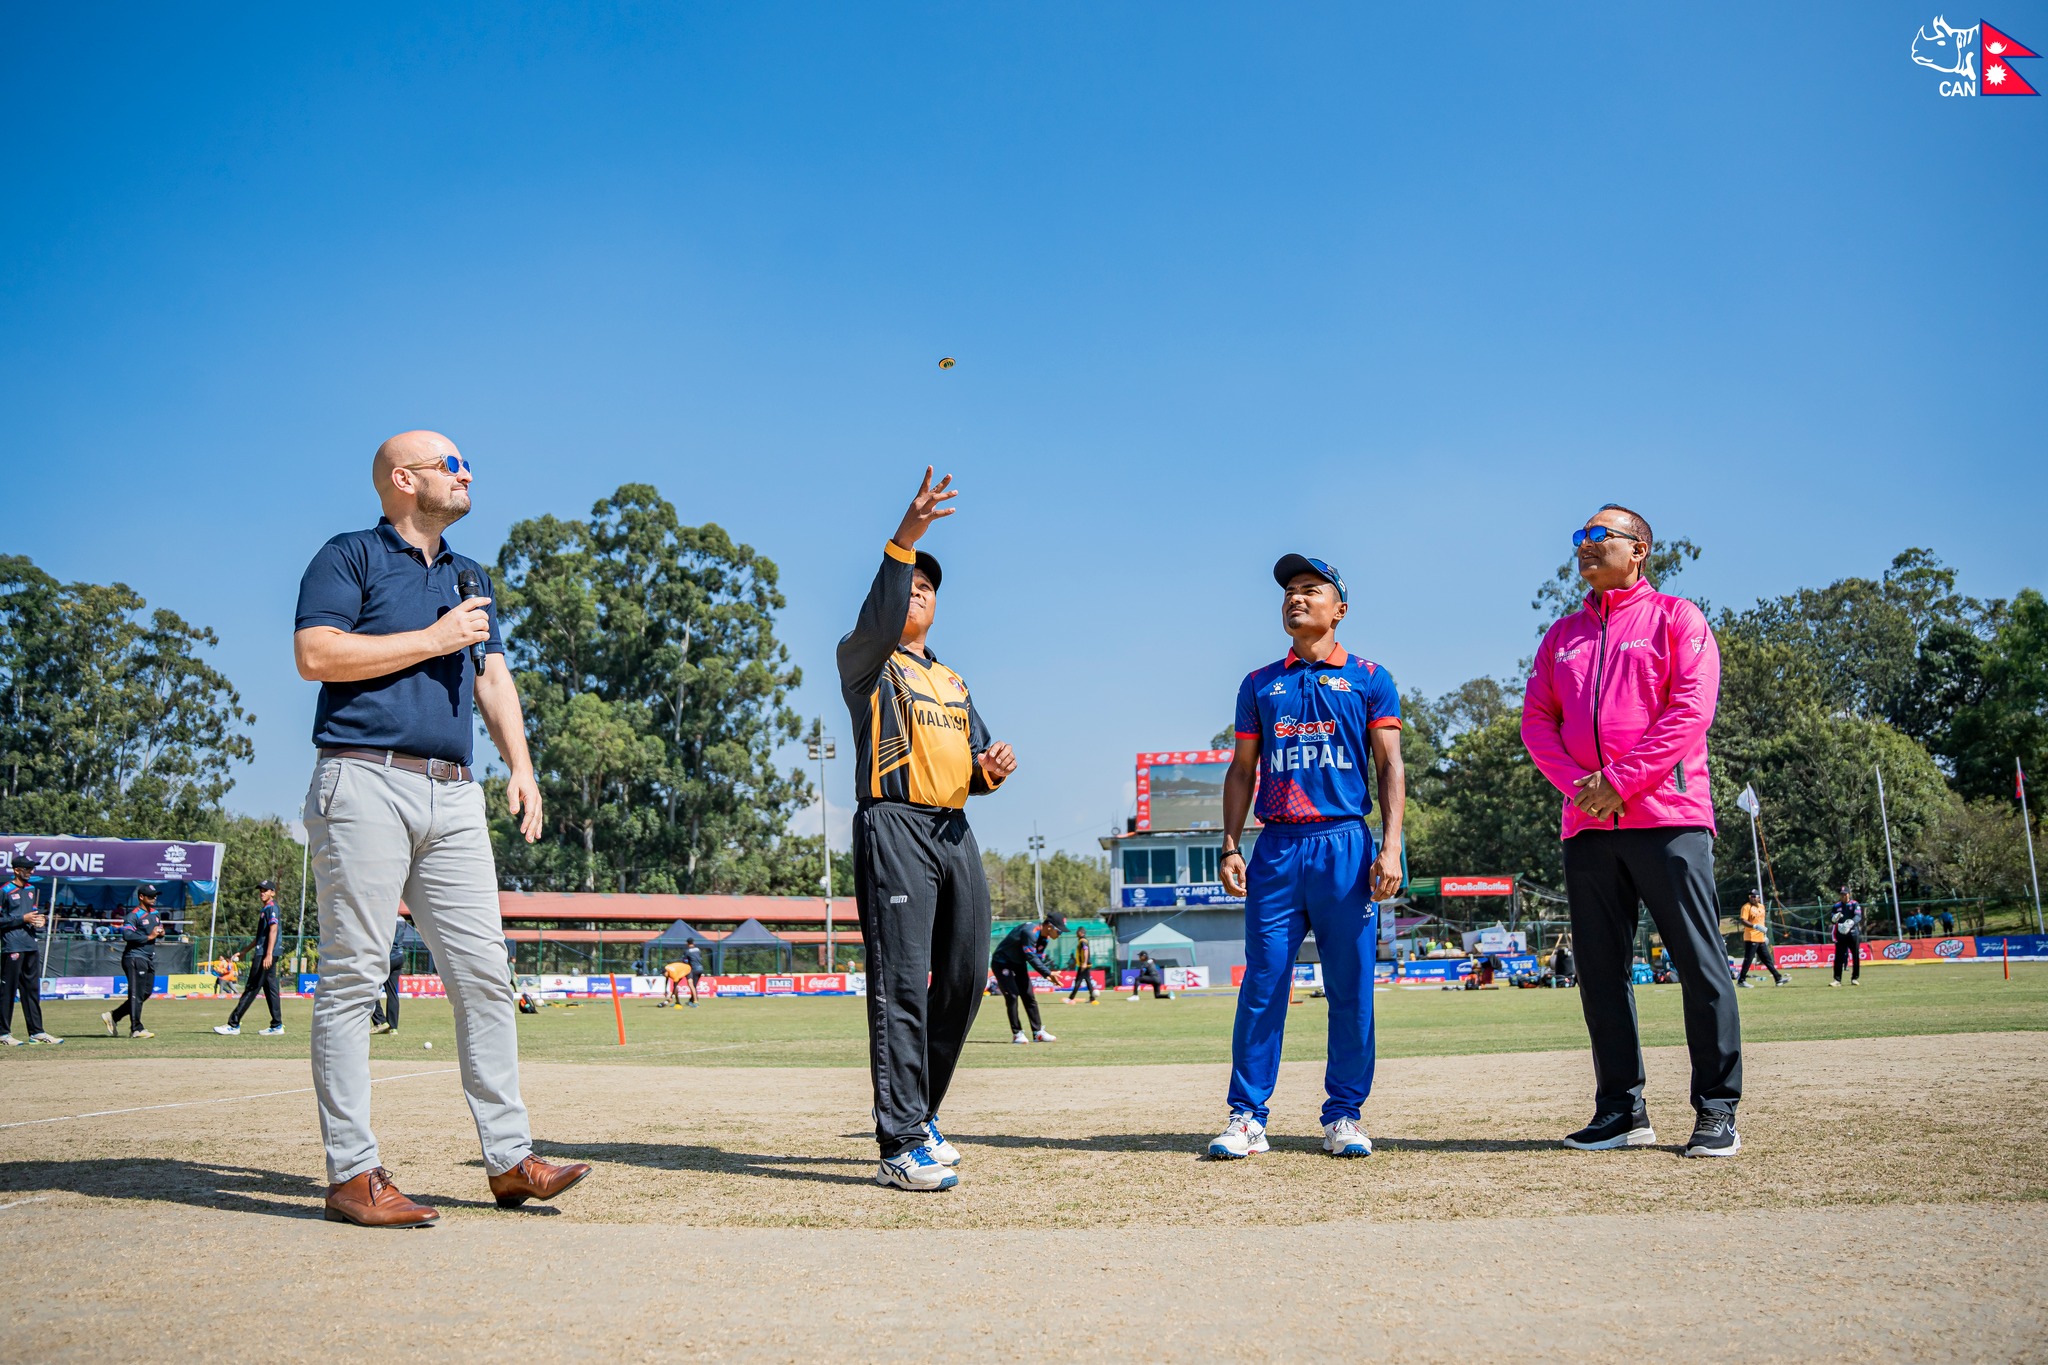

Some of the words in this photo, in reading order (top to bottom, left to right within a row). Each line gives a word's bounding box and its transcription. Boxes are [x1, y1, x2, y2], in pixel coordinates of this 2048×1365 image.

[1630, 638, 1648, 648] ICC
[914, 709, 967, 732] MALAYSI
[1281, 716, 1297, 726] My
[1274, 719, 1336, 738] Second
[1270, 744, 1352, 773] NEPAL
[35, 851, 105, 873] ZONE
[1175, 887, 1191, 897] ICC
[1191, 886, 1219, 896] MEN'S
[1779, 950, 1818, 964] pathao
[1887, 944, 1909, 958] Real
[1938, 943, 1960, 957] Real
[771, 979, 791, 988] IME
